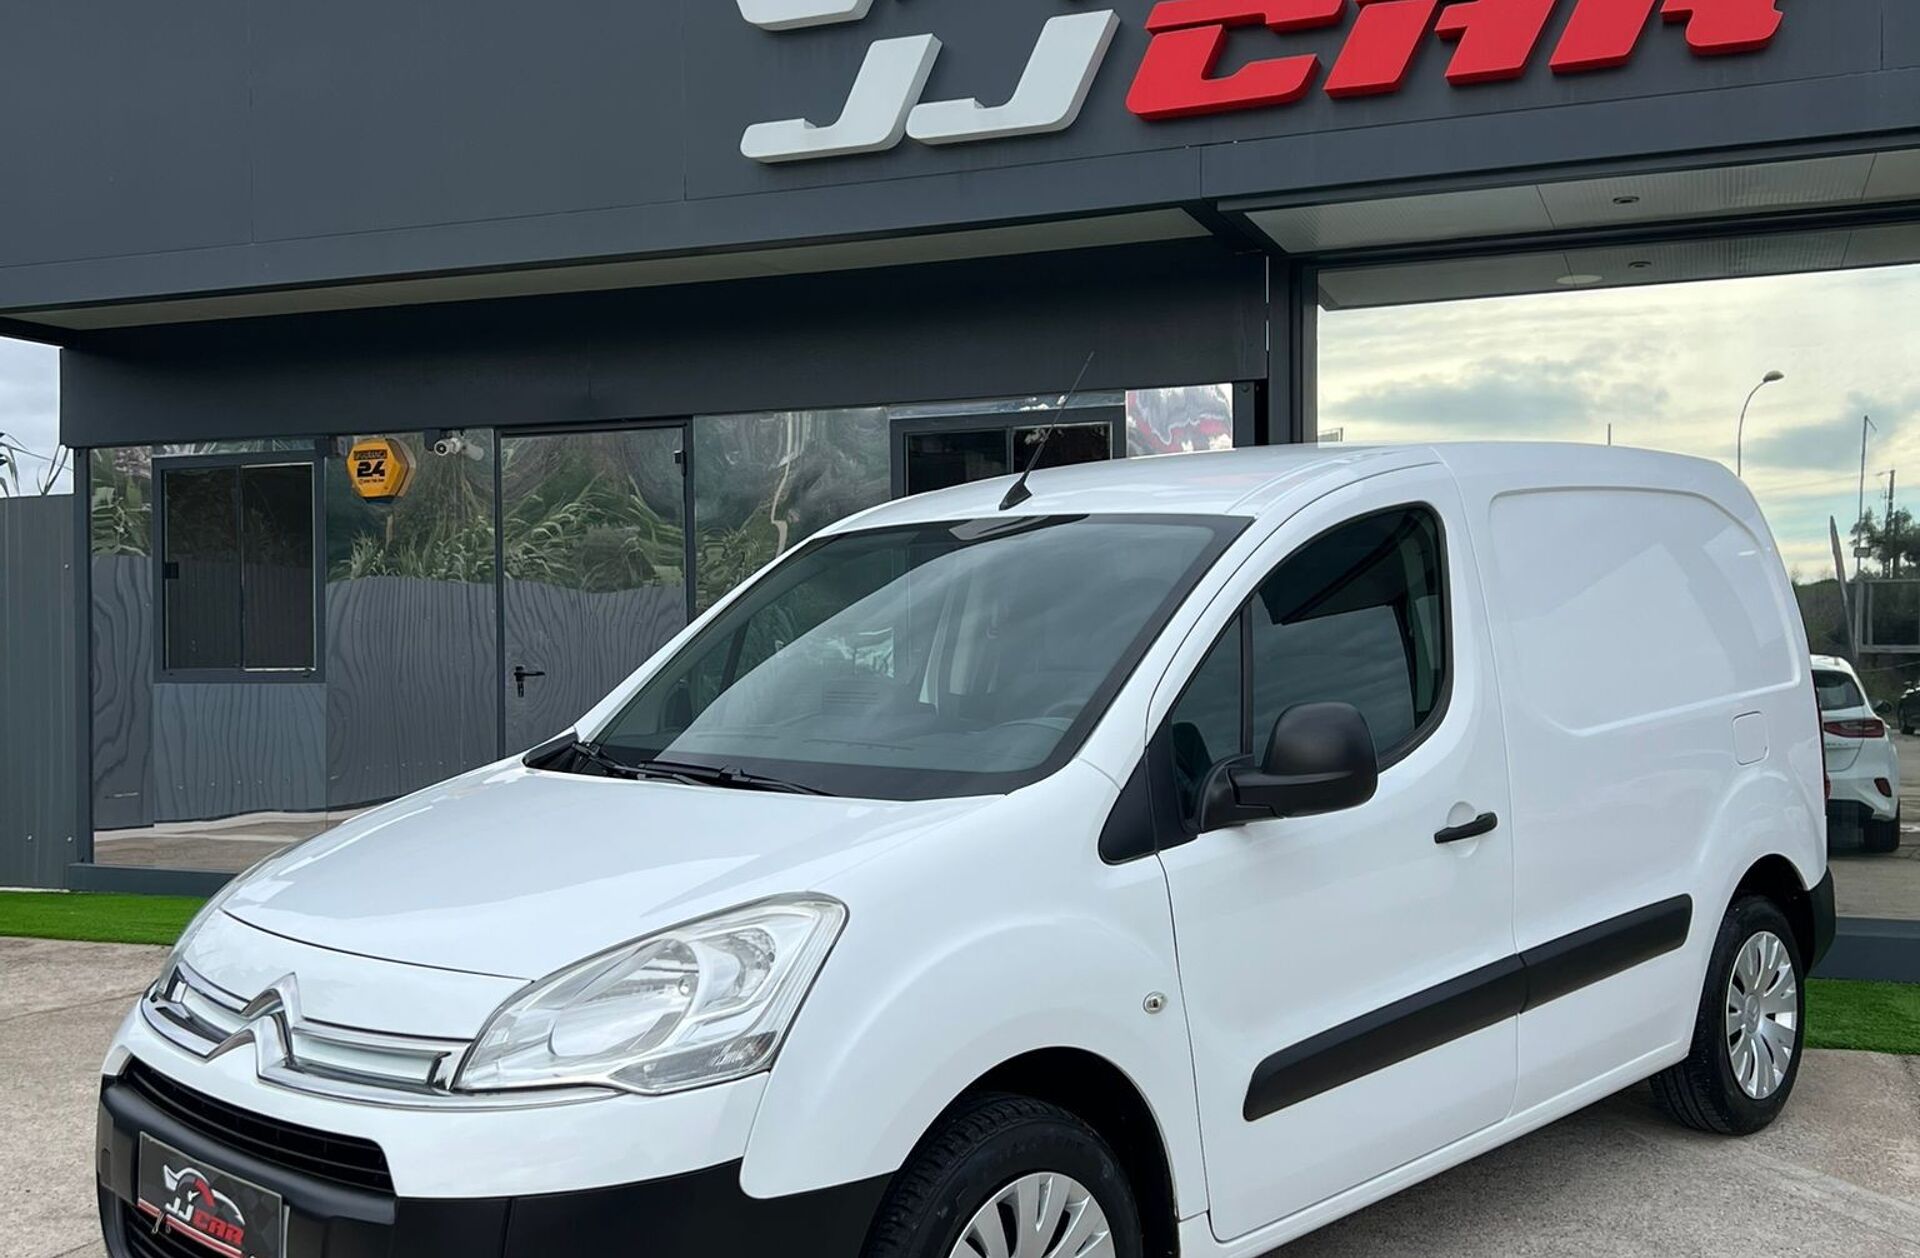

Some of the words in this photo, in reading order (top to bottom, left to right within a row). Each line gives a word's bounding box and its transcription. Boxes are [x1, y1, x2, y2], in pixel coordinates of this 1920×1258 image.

[740, 9, 1121, 163] JJ
[357, 461, 386, 477] 24
[165, 1197, 193, 1222] JJ
[194, 1210, 245, 1245] CAR
